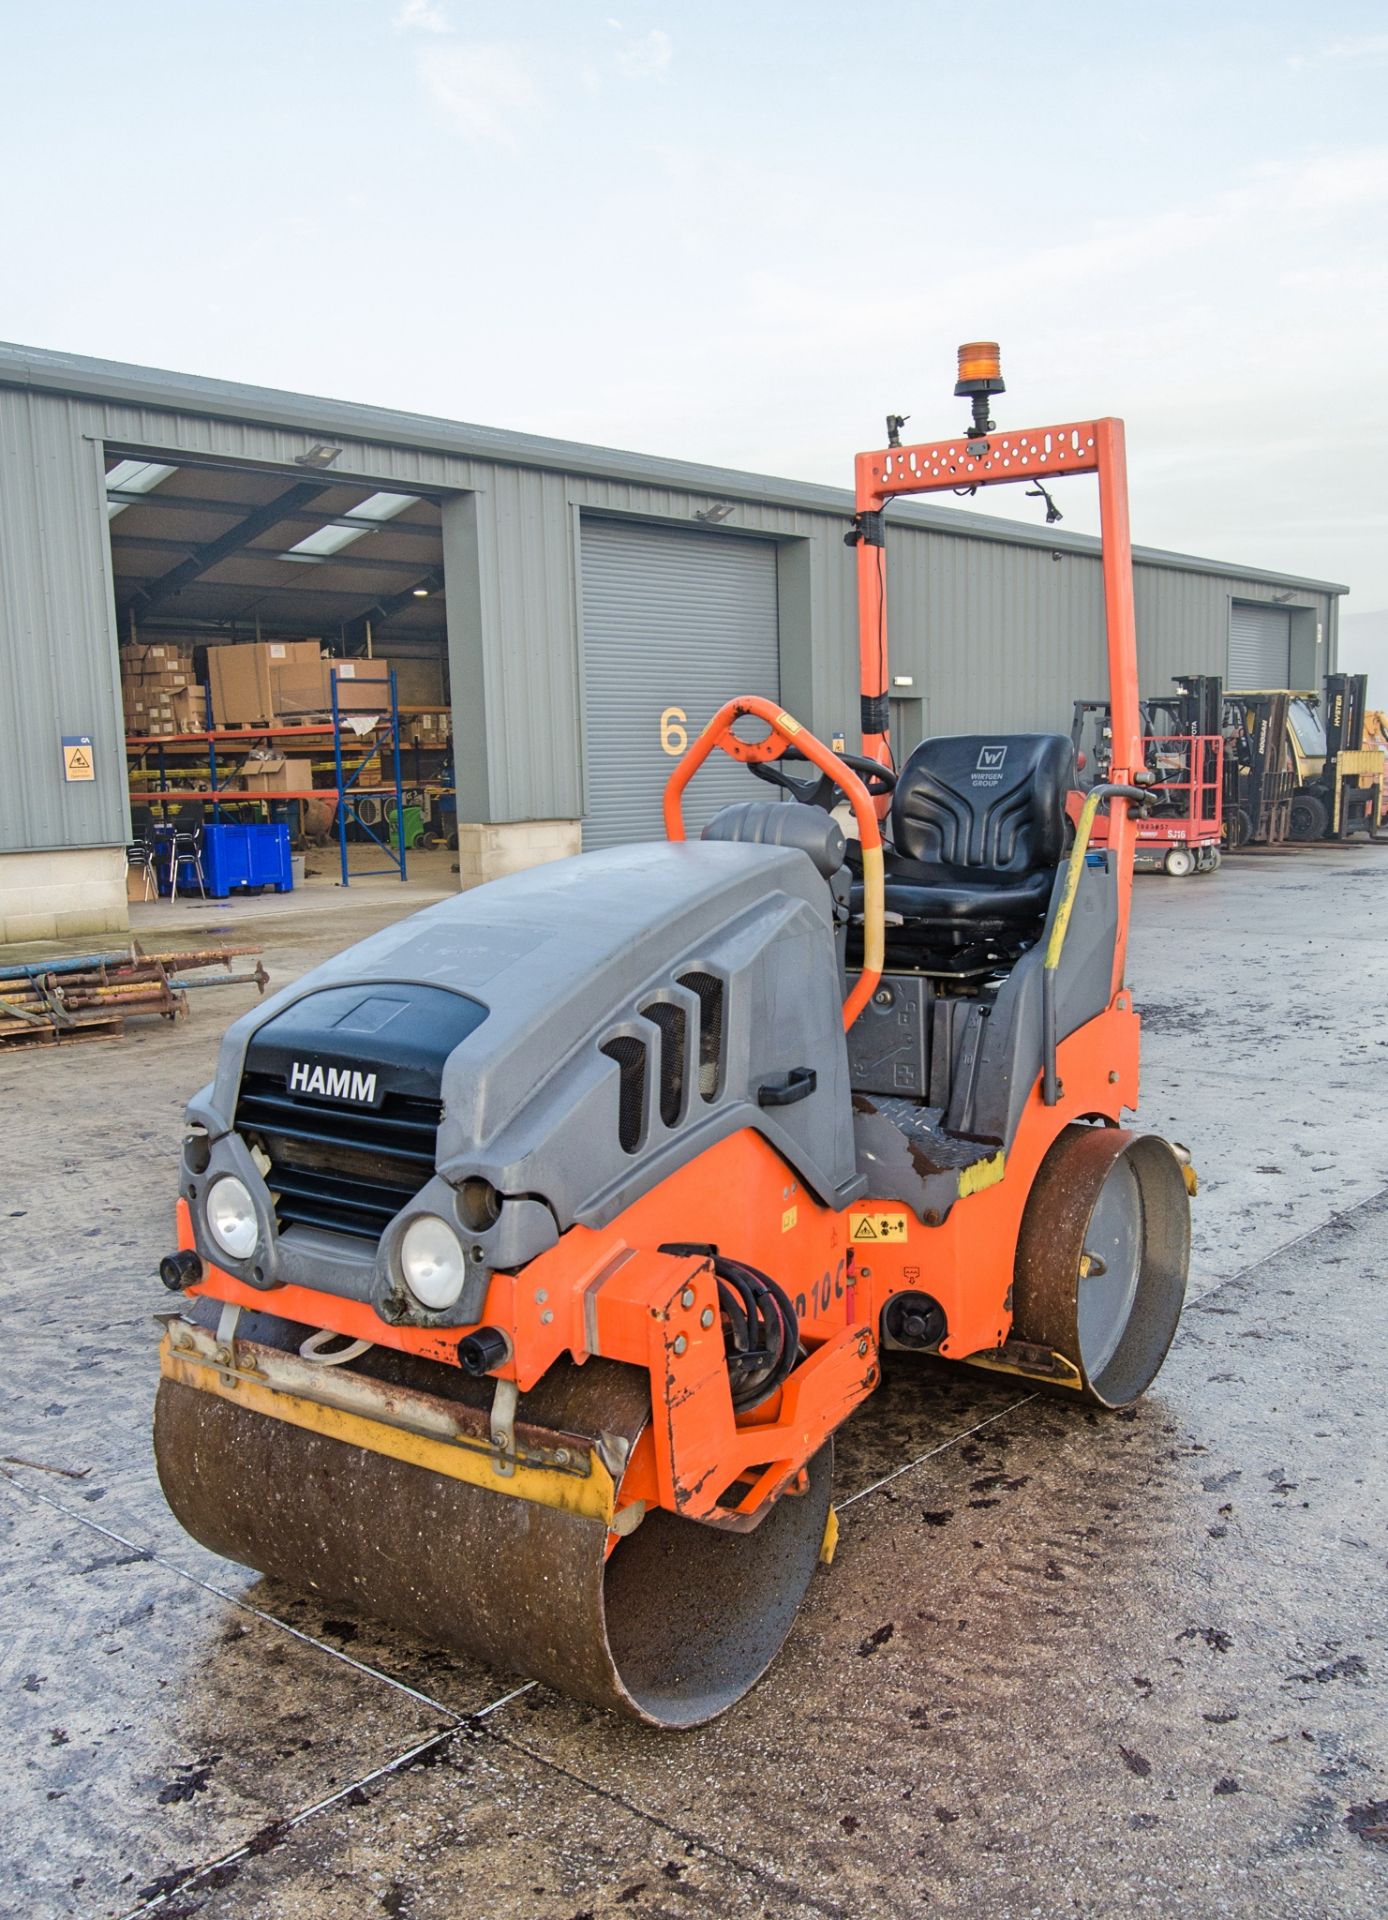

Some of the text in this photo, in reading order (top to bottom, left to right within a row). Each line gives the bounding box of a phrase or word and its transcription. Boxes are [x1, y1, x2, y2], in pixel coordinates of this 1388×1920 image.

[1334, 695, 1342, 727] HYSTER
[661, 707, 688, 756] 6
[1167, 829, 1186, 839] SJ16
[290, 1062, 377, 1103] HAMM
